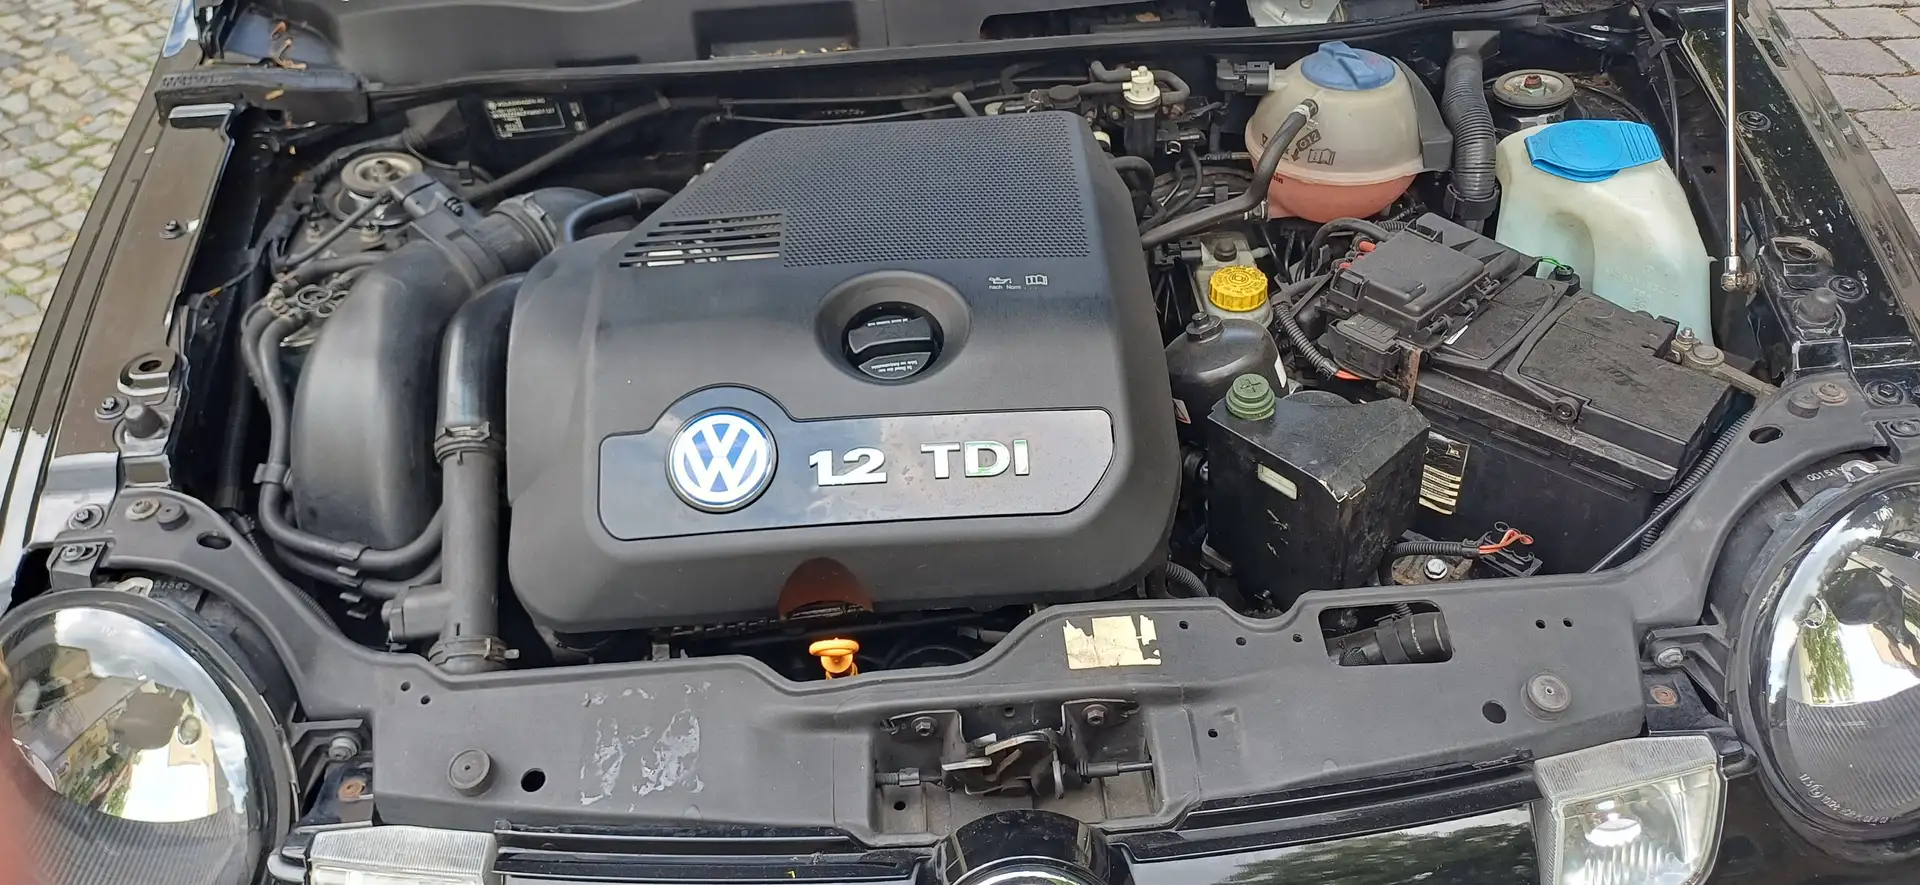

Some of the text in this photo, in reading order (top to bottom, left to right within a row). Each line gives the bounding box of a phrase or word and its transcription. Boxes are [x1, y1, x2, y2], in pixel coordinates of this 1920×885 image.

[1299, 131, 1320, 150] G12
[672, 413, 771, 502] VW
[921, 440, 1030, 479] TDI
